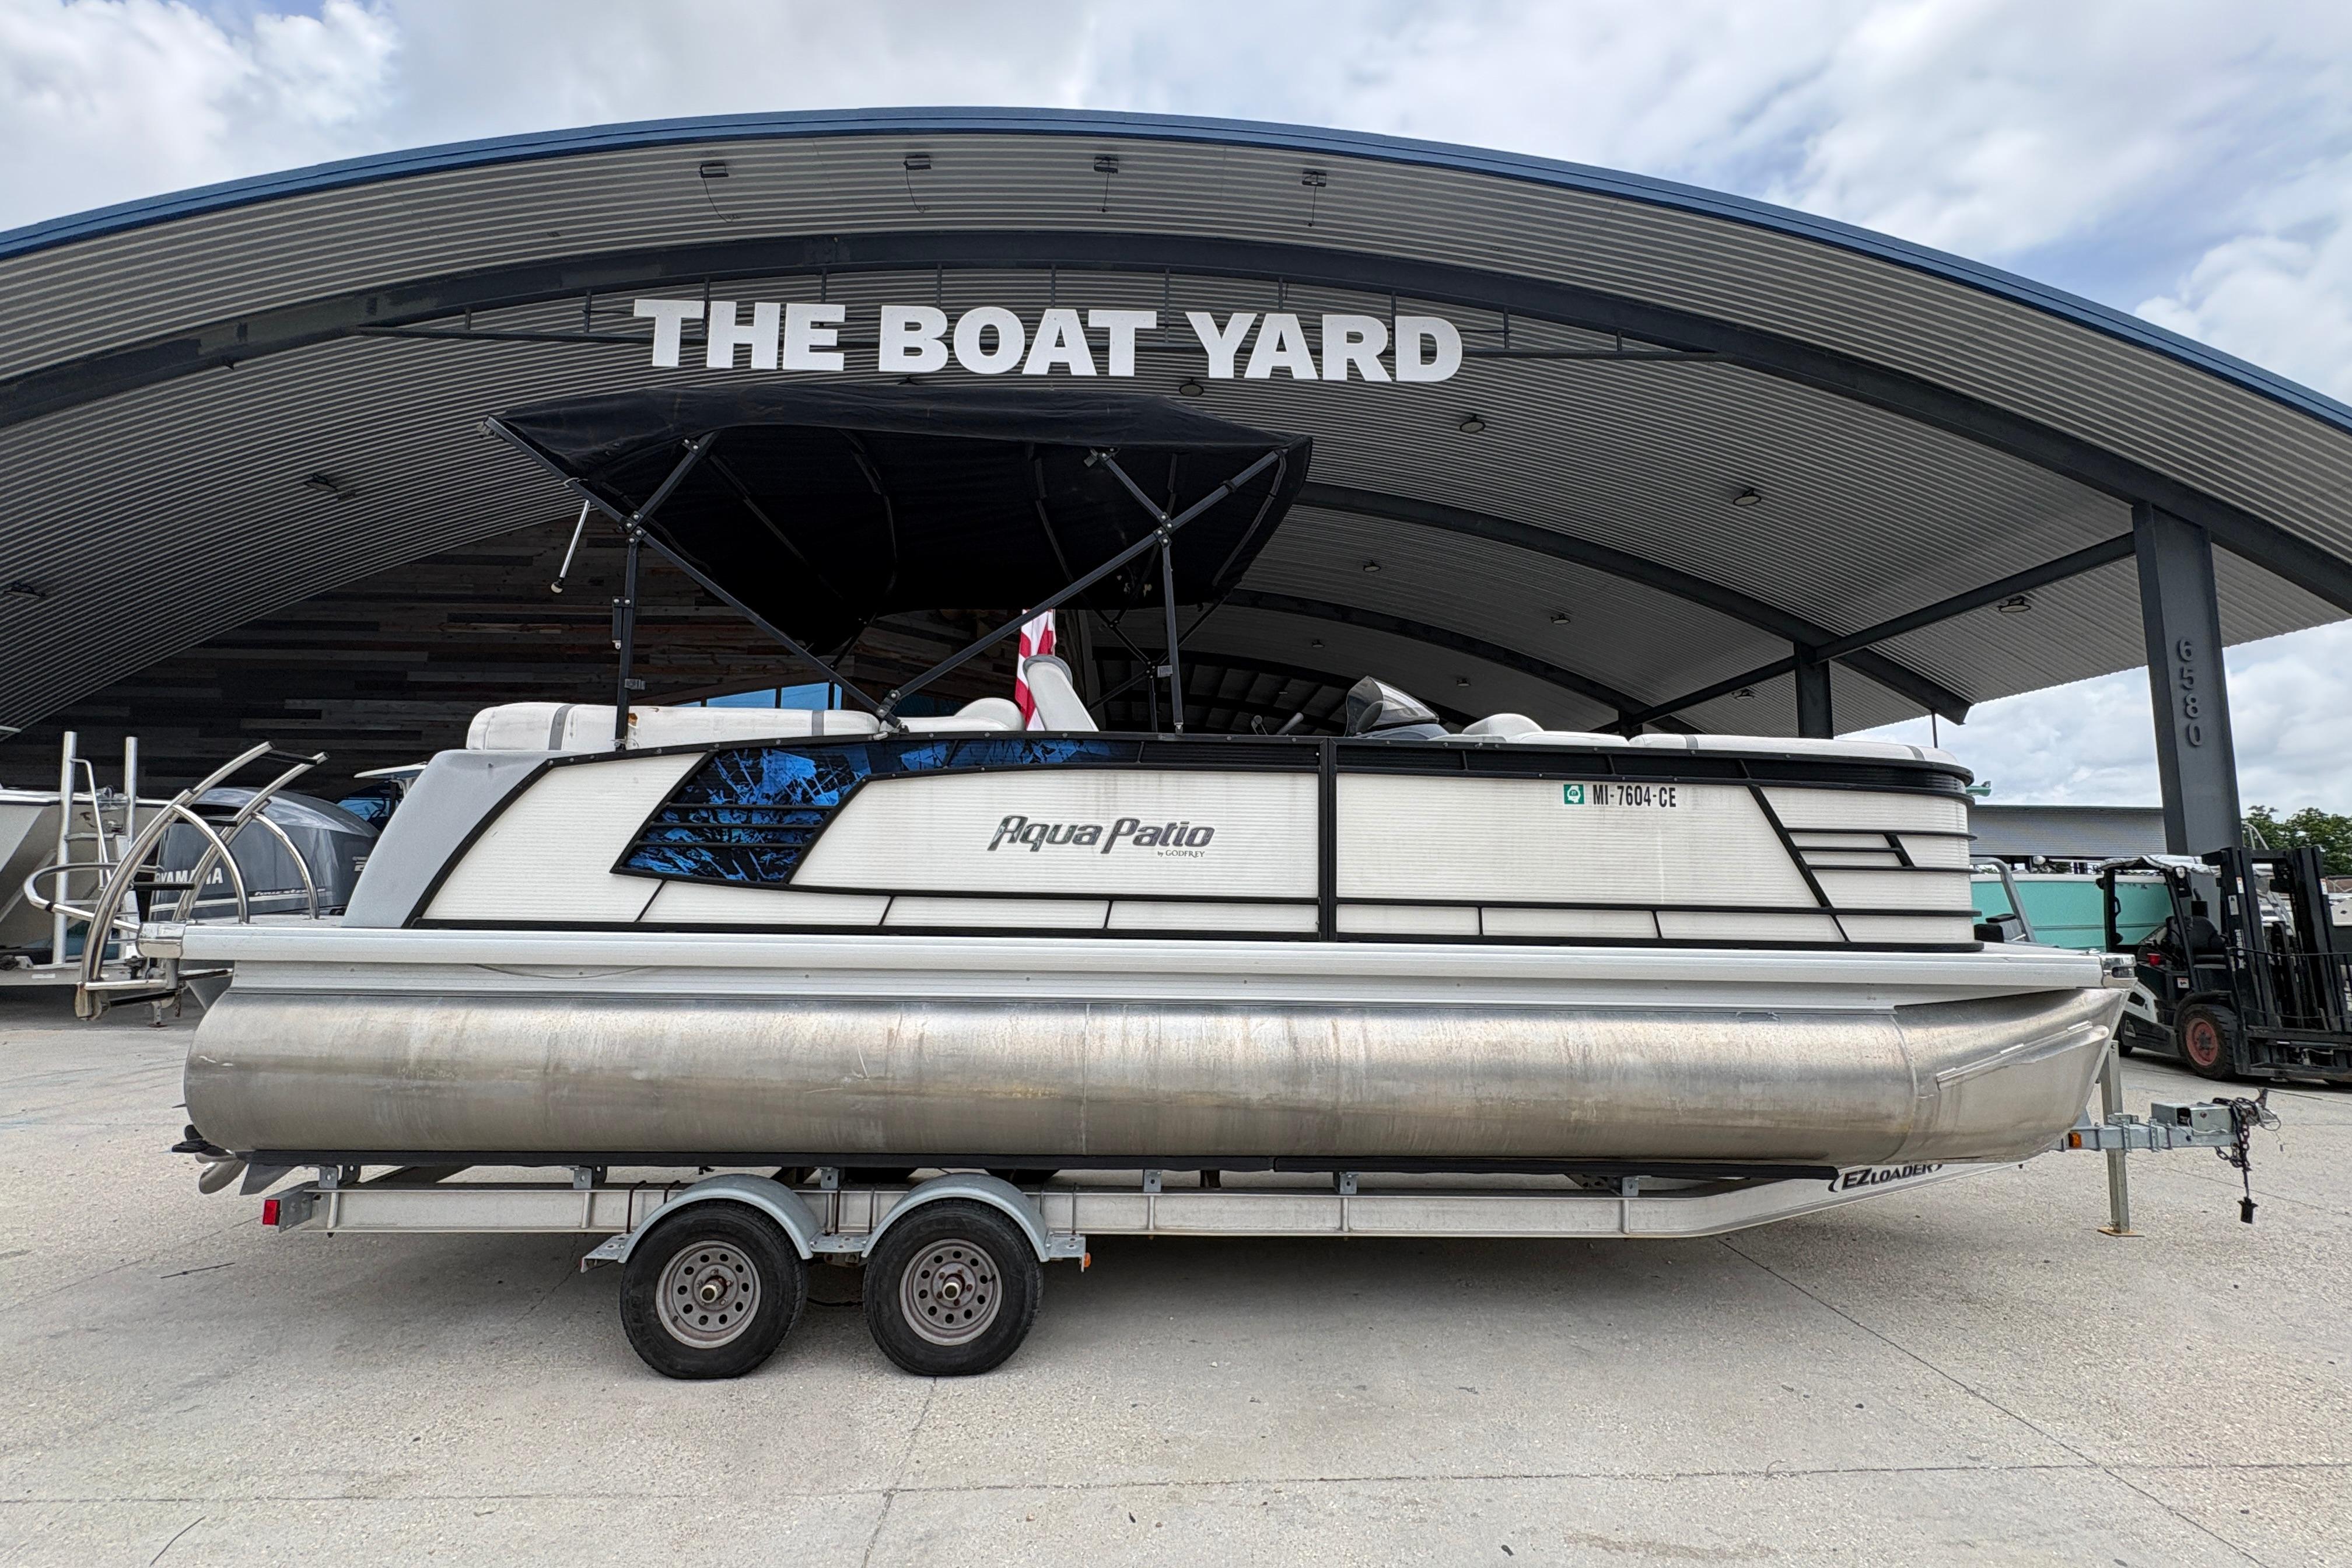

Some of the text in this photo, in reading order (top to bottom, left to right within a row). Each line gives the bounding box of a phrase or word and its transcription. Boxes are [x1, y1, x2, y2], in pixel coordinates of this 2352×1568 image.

[634, 299, 1462, 382] THE BOAT YARD
[2178, 638, 2203, 746] 6580
[1593, 784, 1676, 807] MI-7604-CE
[987, 816, 1215, 854] Aqua Patio
[1166, 849, 1205, 858] GODFREY
